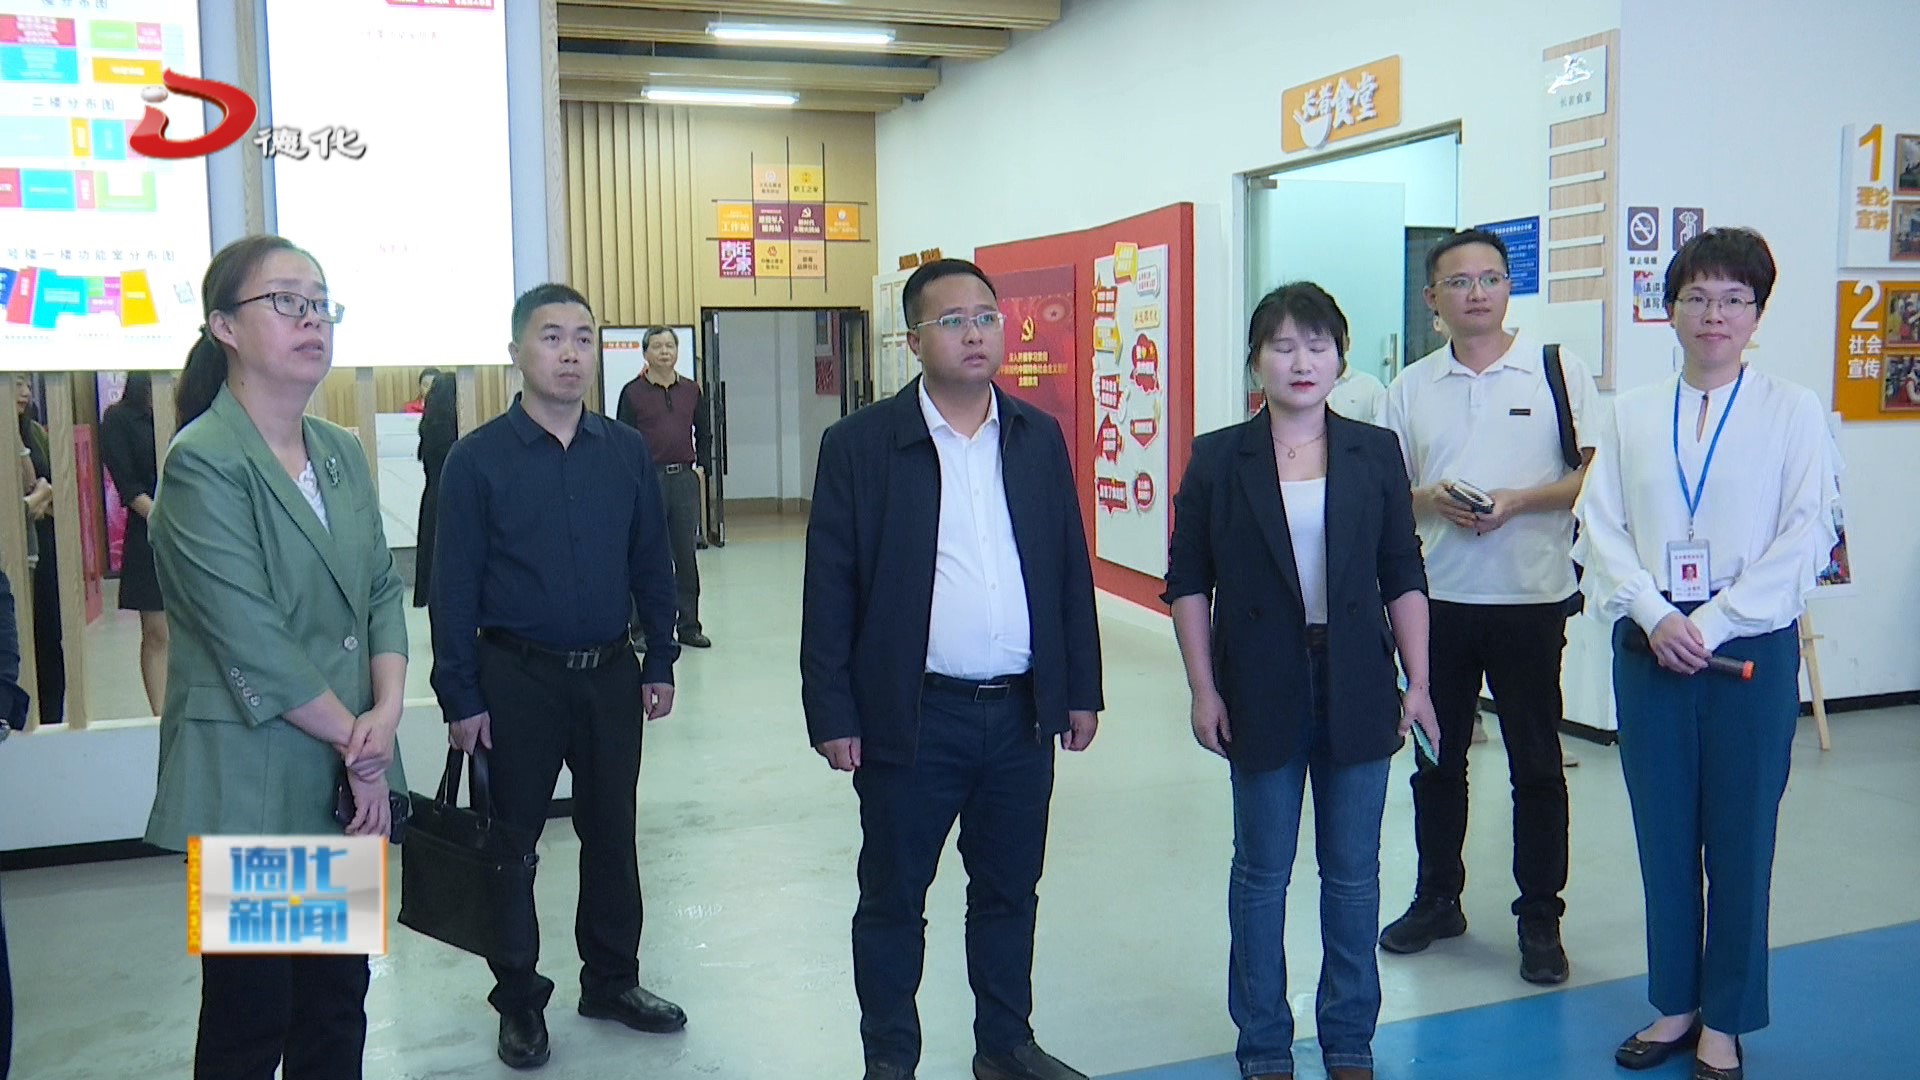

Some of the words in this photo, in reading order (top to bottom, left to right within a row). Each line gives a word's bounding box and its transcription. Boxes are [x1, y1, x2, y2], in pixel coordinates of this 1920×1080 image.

[32, 97, 114, 111] 二楼分布图
[1859, 123, 1882, 181] 1
[1857, 186, 1889, 207] 理论
[721, 222, 750, 233] 工作站
[1851, 279, 1882, 330] 2
[1849, 334, 1882, 354] 社会
[1848, 358, 1881, 379] 宣传
